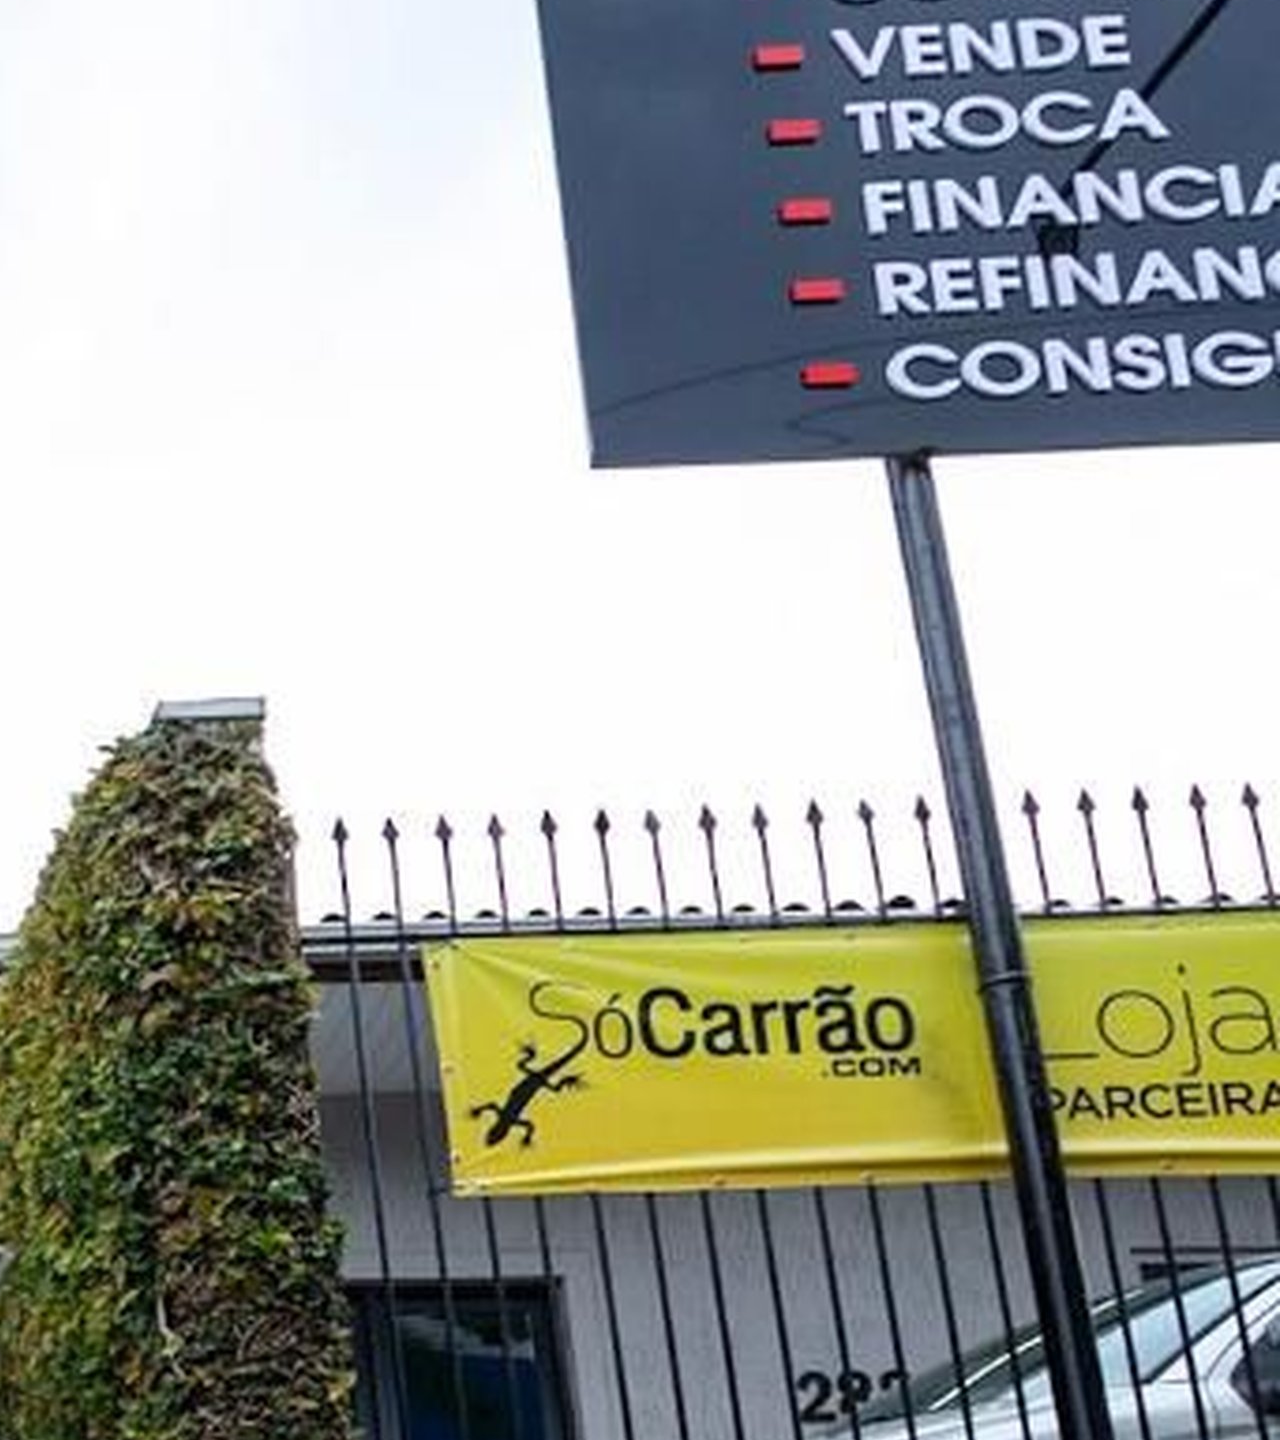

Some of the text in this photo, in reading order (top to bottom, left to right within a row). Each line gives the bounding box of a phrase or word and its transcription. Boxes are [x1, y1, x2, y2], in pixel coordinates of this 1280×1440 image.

[830, 13, 1132, 79] VENDE
[844, 88, 1170, 154] TROCA
[873, 245, 1280, 315] REFINAN
[884, 329, 1280, 400] CONSIG
[820, 1057, 922, 1077] .COM
